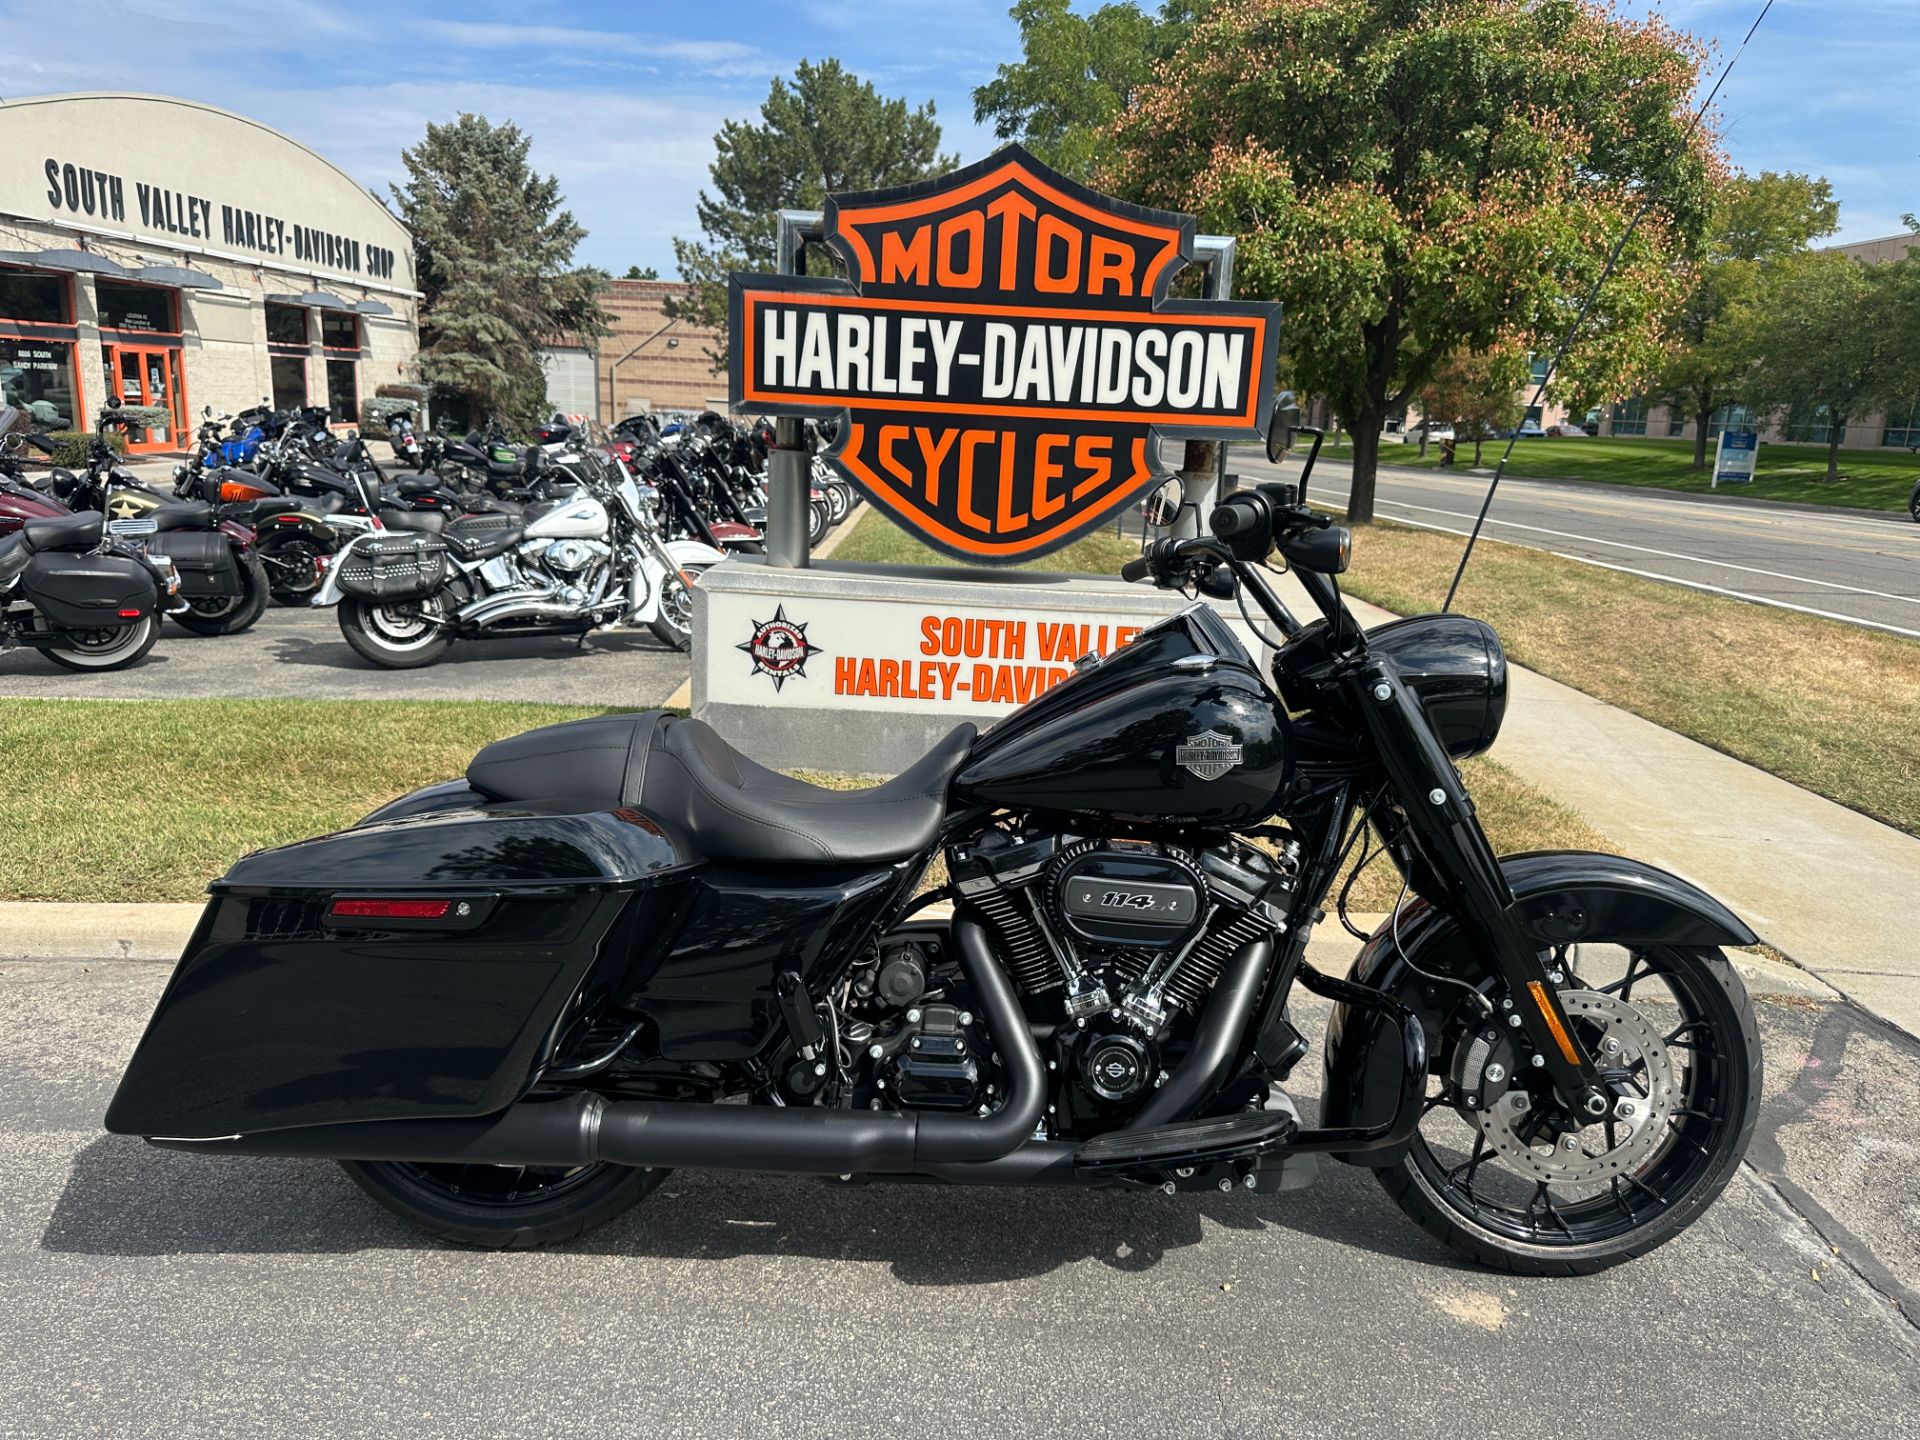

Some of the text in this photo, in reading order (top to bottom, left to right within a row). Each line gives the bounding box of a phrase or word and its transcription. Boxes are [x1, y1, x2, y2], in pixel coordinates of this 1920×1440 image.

[45, 158, 395, 280] SOUTH VALLEY HARLEY-DAVIDSON SHOP
[880, 190, 1137, 296] MOTOR
[763, 308, 1245, 410] HARLEY-DAVIDSON
[878, 424, 1113, 534] CYCLES
[754, 644, 803, 660] HARLEY-DAVIDSON
[757, 621, 803, 639] AUTHORIZED
[920, 615, 1143, 662] SOUTH VALLE
[835, 656, 1078, 704] HARLEY-DAVID
[1101, 891, 1155, 909] 114
